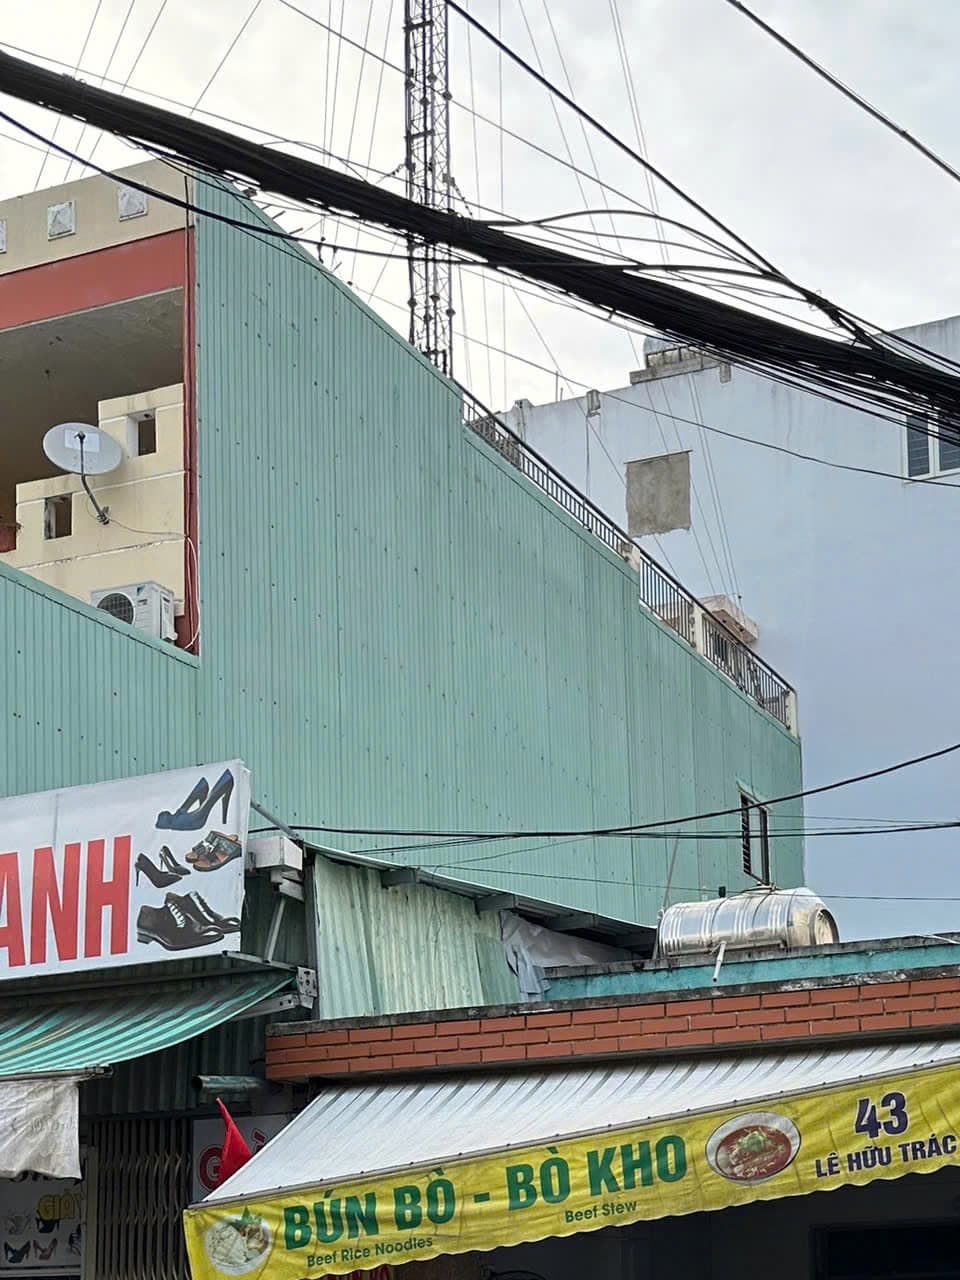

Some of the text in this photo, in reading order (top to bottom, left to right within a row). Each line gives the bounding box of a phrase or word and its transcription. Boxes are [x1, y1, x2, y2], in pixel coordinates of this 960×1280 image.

[0, 835, 131, 968] ANH
[855, 1091, 909, 1139] 43
[815, 1133, 957, 1178] LÊ HỮU TRÁC
[283, 1188, 379, 1251] BÚN
[394, 1166, 457, 1231] BÒ
[506, 1146, 572, 1212] BÒ
[587, 1134, 689, 1197] KHO
[565, 1199, 638, 1224] Beef Stew
[307, 1236, 433, 1268] Beef Rice Noodles
